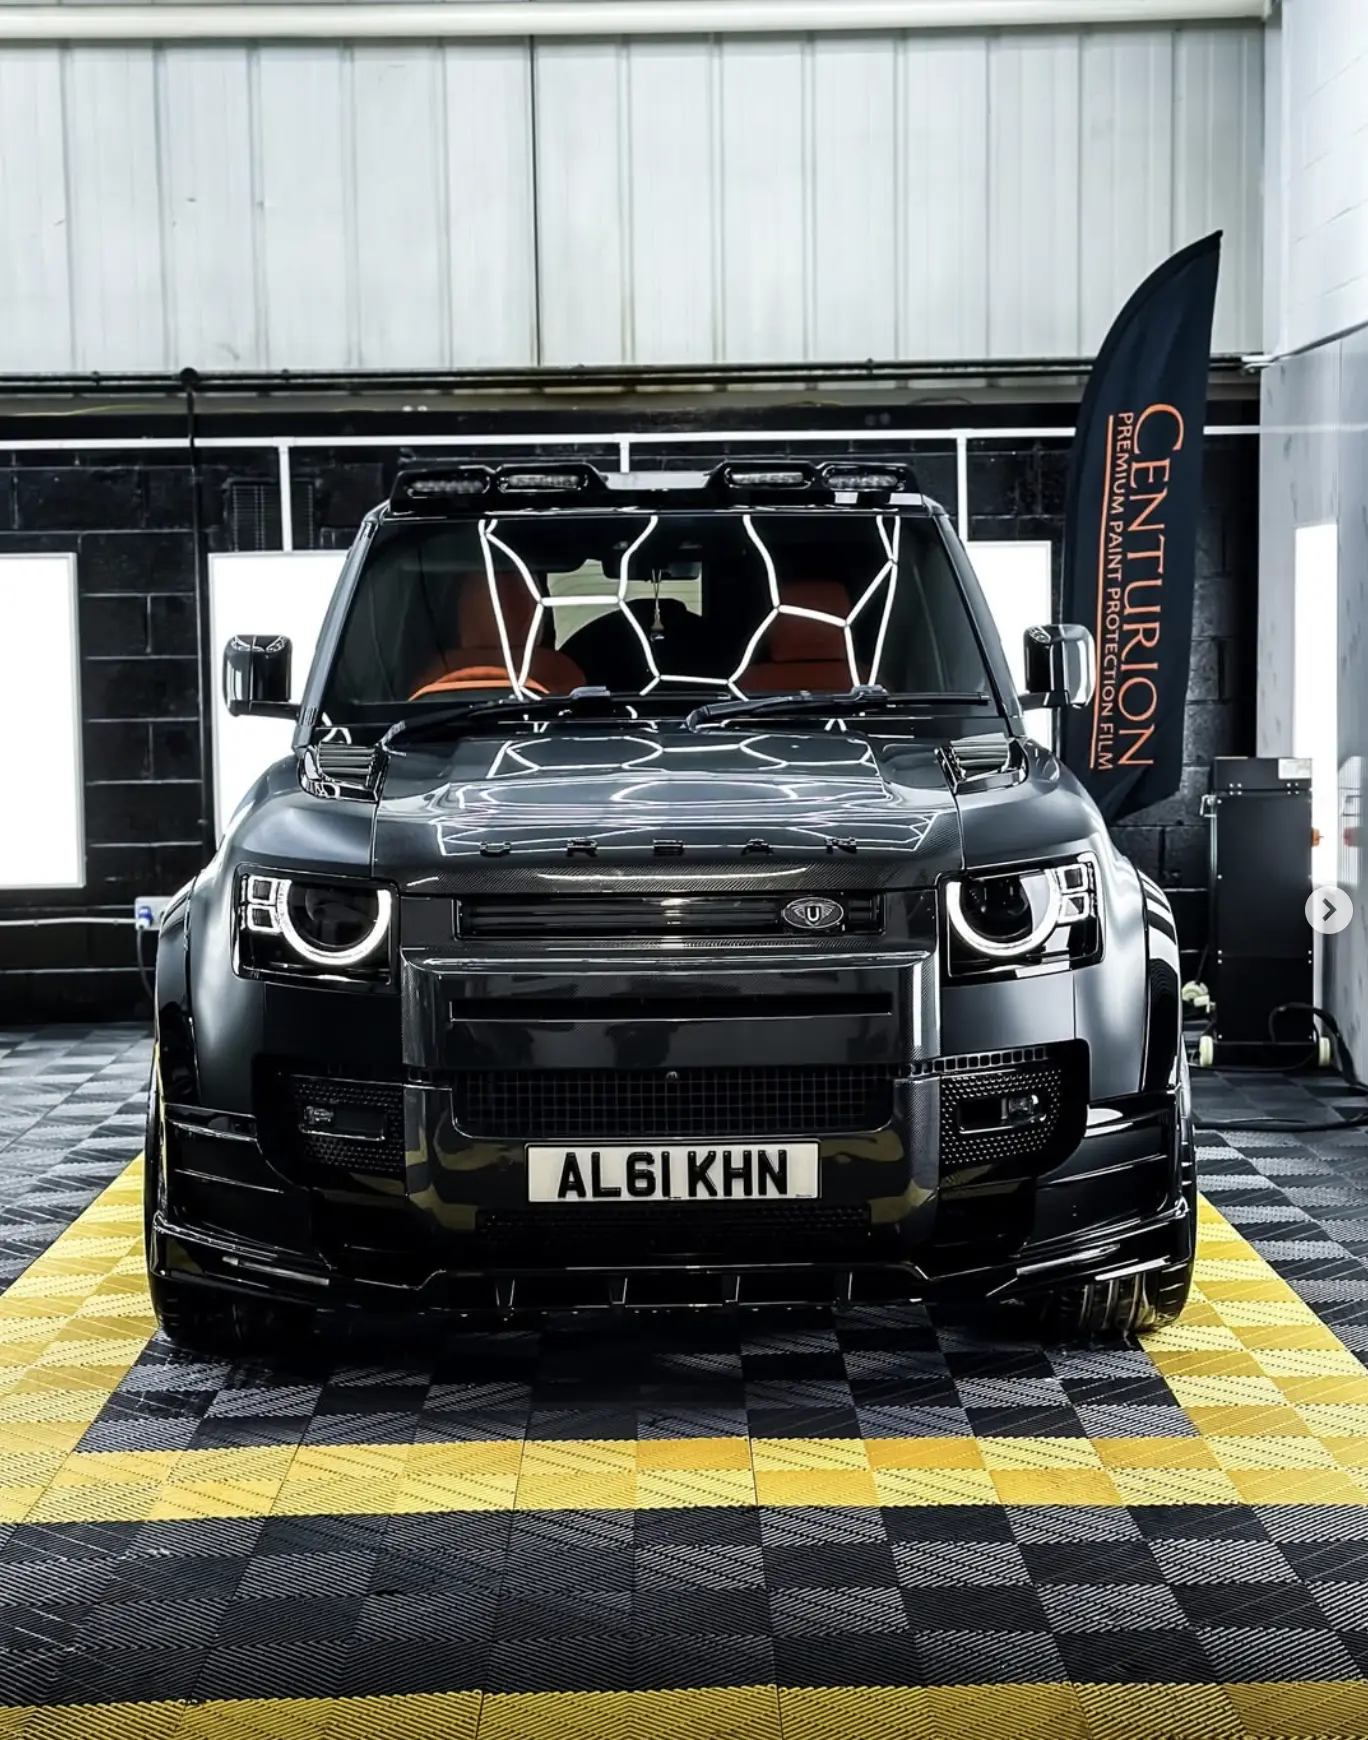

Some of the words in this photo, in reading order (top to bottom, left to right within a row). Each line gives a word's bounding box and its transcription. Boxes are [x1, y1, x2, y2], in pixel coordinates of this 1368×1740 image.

[1109, 412, 1134, 515] PREMIUM
[1107, 520, 1124, 582] PAINT
[1117, 403, 1184, 765] CENTURION
[1100, 587, 1122, 717] PROTECTION
[1097, 723, 1114, 770] FILM
[479, 837, 858, 858] URBAN
[807, 906, 820, 922] U
[687, 1149, 788, 1198] KHN
